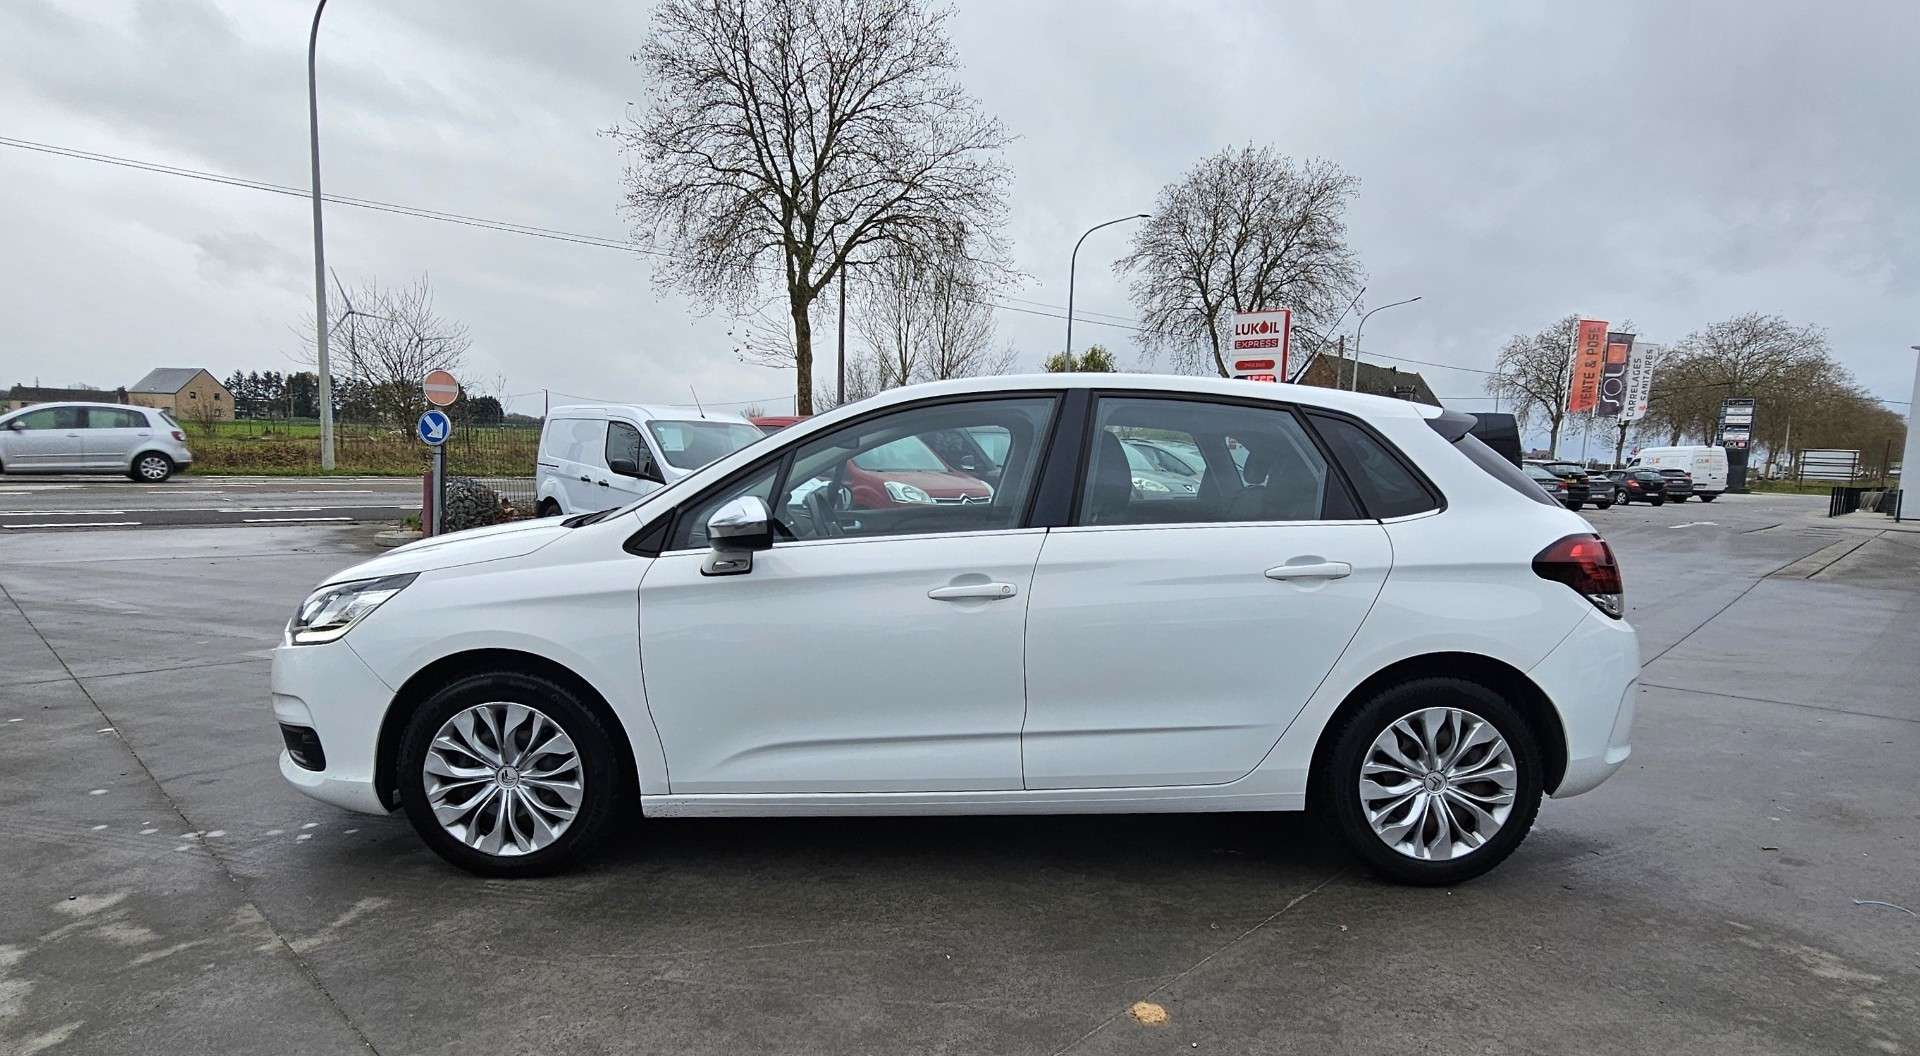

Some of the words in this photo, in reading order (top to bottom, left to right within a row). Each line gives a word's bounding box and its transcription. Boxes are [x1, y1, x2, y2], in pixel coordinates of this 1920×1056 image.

[1235, 320, 1279, 335] LUKOIL
[1587, 327, 1600, 356] POSE
[1236, 340, 1277, 349] EXPRESS
[1585, 360, 1596, 368] &
[1640, 349, 1654, 401] SANITAIRES
[1580, 372, 1596, 406] VENTE
[1626, 358, 1641, 417] CARRELAGES
